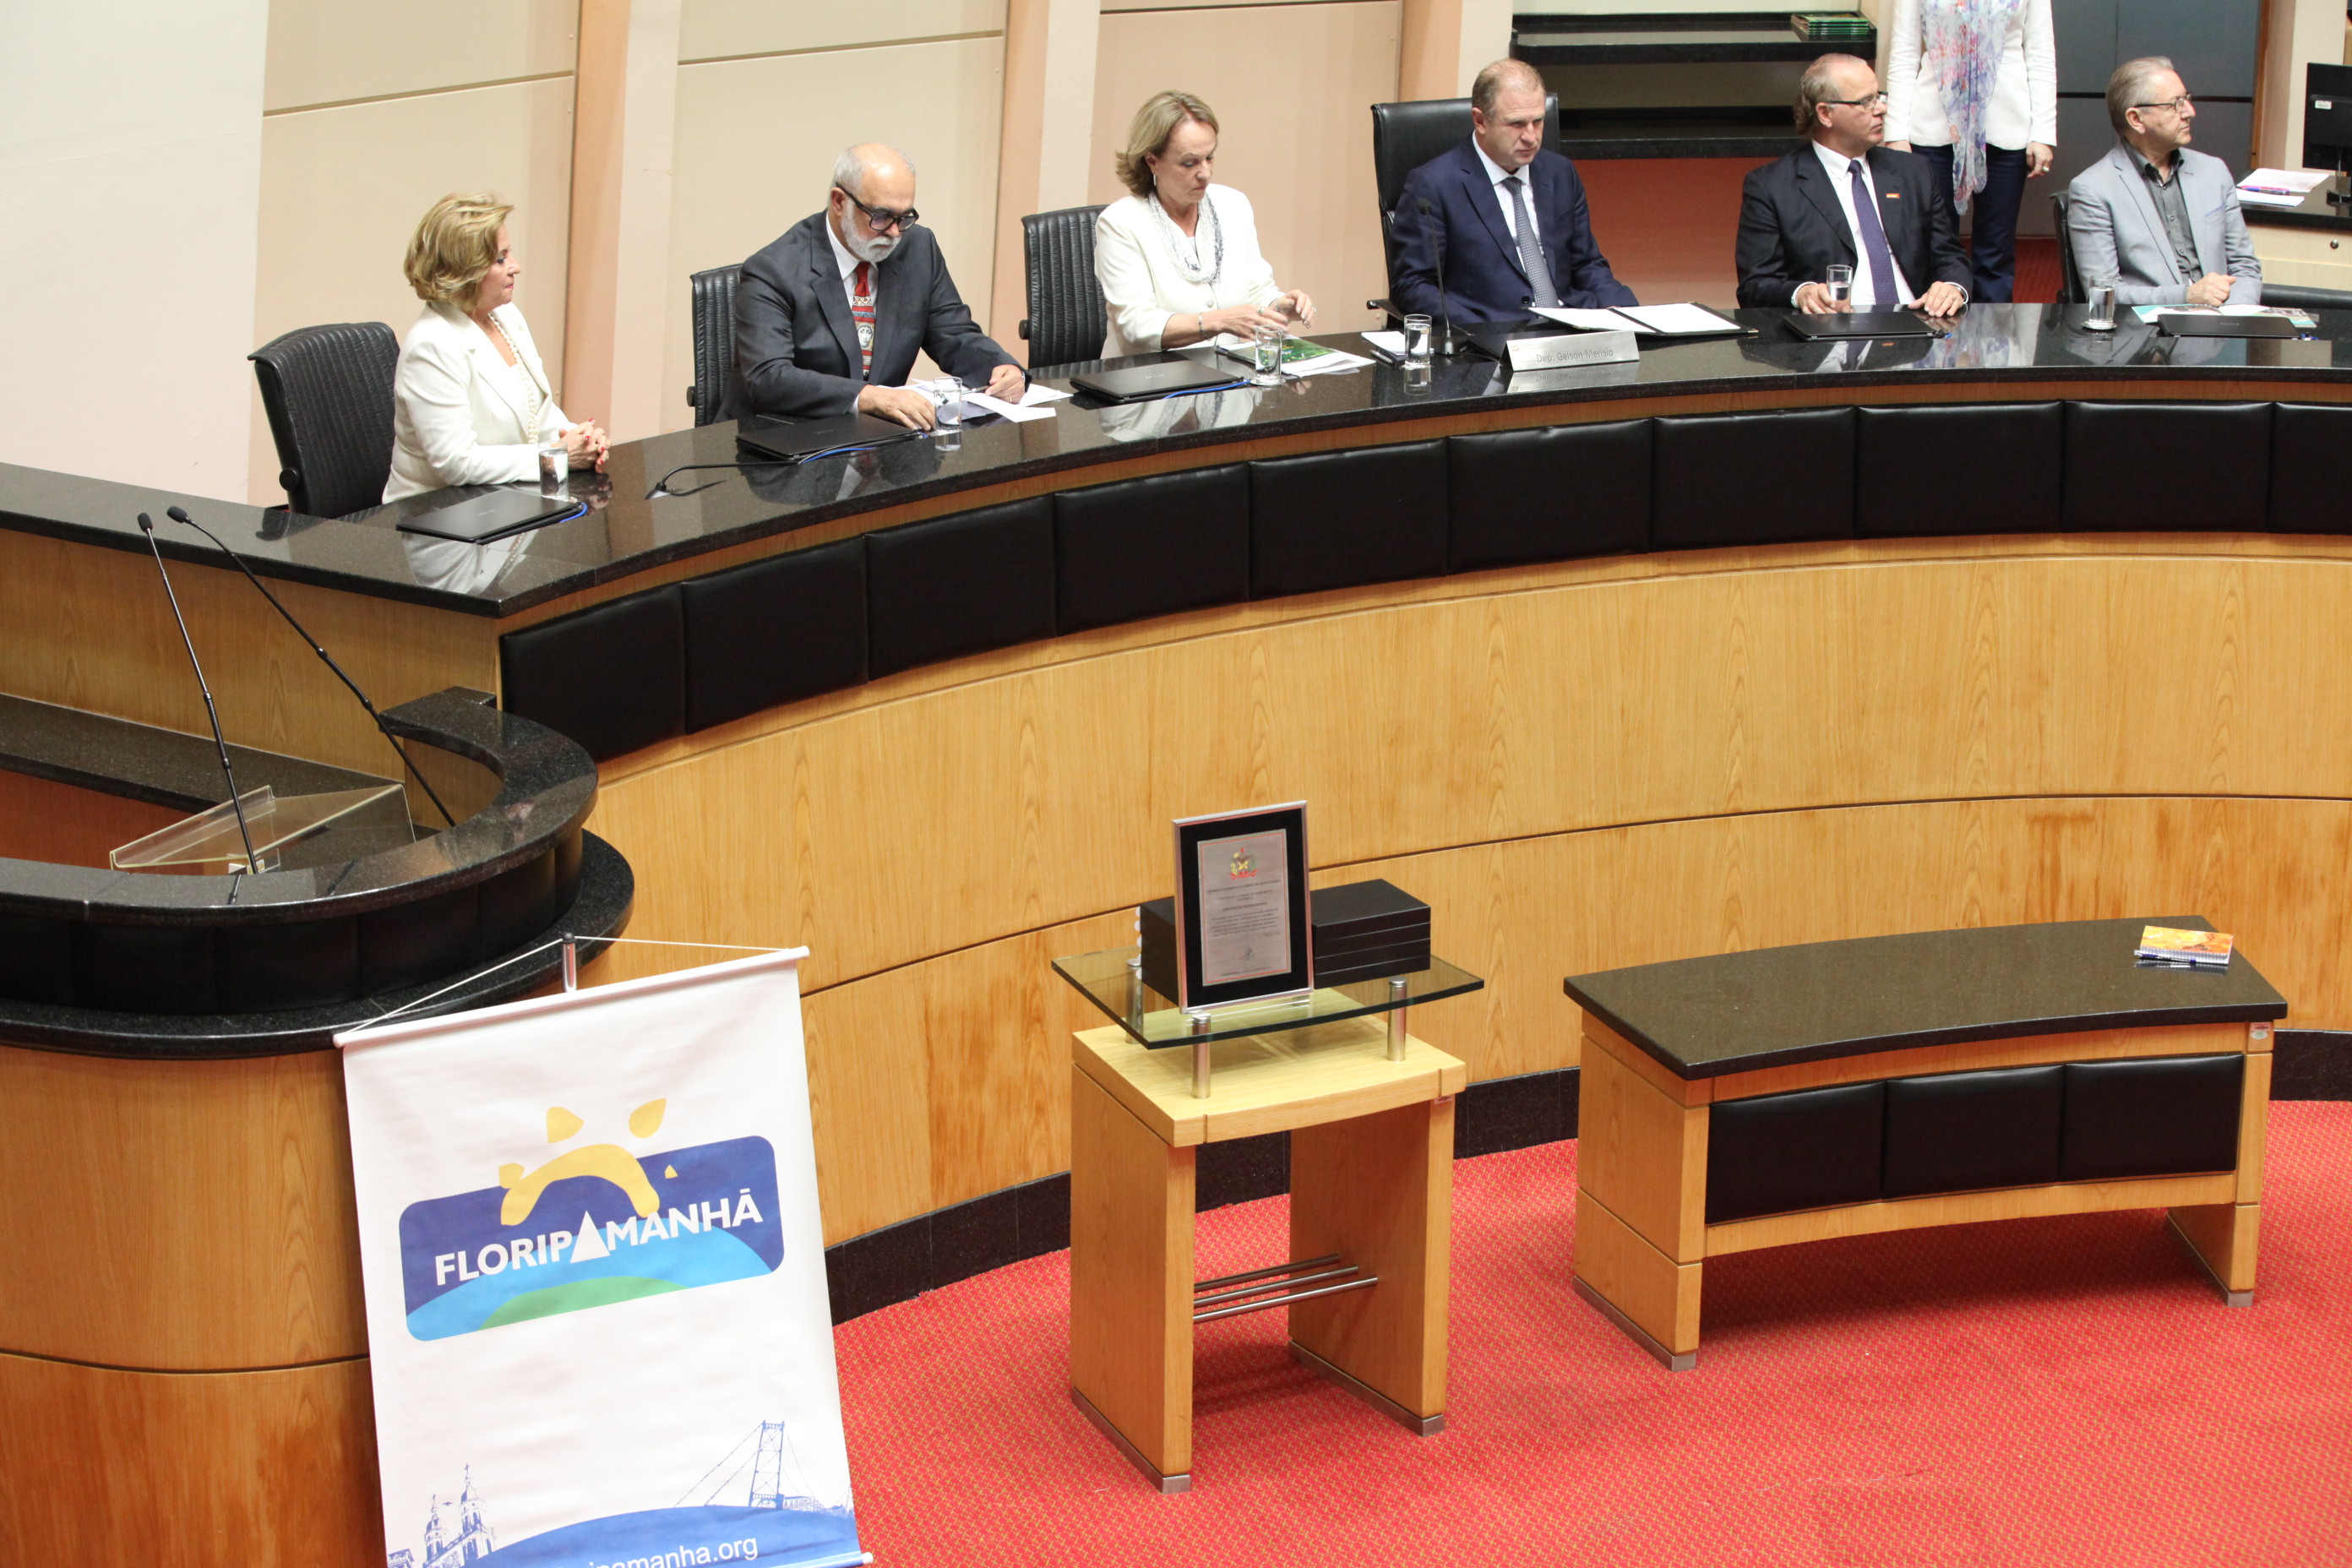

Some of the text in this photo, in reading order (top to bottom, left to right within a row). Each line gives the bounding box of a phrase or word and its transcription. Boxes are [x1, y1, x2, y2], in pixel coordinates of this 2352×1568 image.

[1536, 348, 1614, 364] Dep. Gelson Merisio
